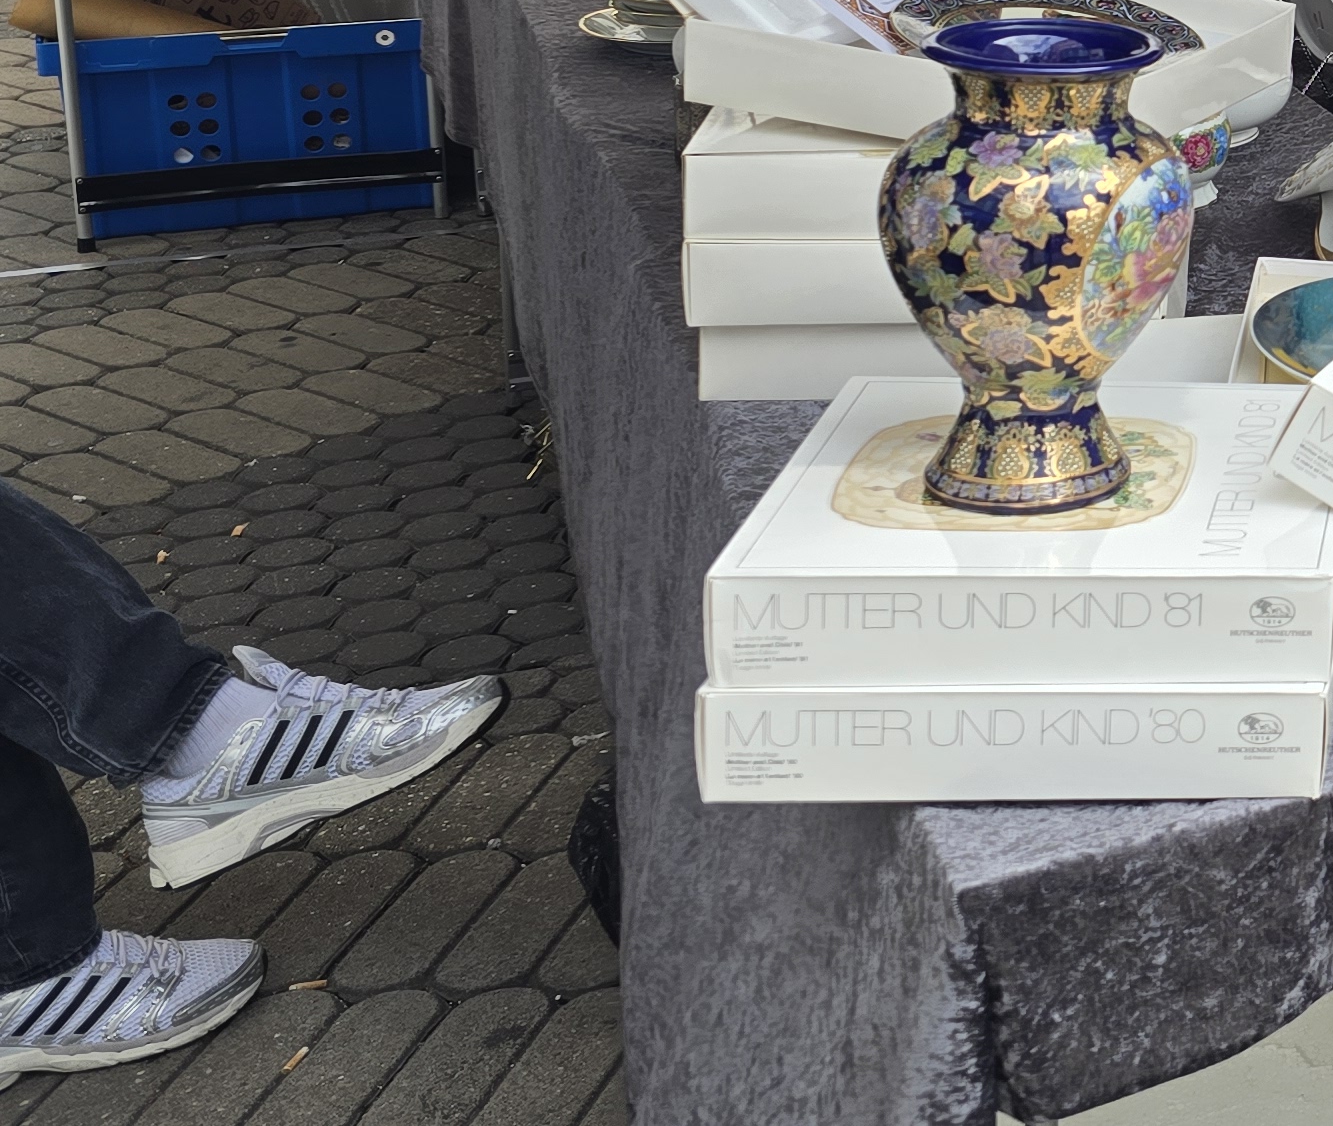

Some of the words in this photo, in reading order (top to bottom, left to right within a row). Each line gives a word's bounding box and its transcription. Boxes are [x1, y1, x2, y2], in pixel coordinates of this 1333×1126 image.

[1232, 416, 1277, 448] KIND
[1220, 451, 1268, 486] UND
[1198, 489, 1257, 556] MUTTER
[732, 592, 923, 630] MUTTER
[938, 592, 1036, 630] UND
[1052, 592, 1152, 629] KIND
[724, 710, 912, 747] MUTTER
[927, 710, 1025, 747] UND
[1040, 709, 1141, 746] KIND
